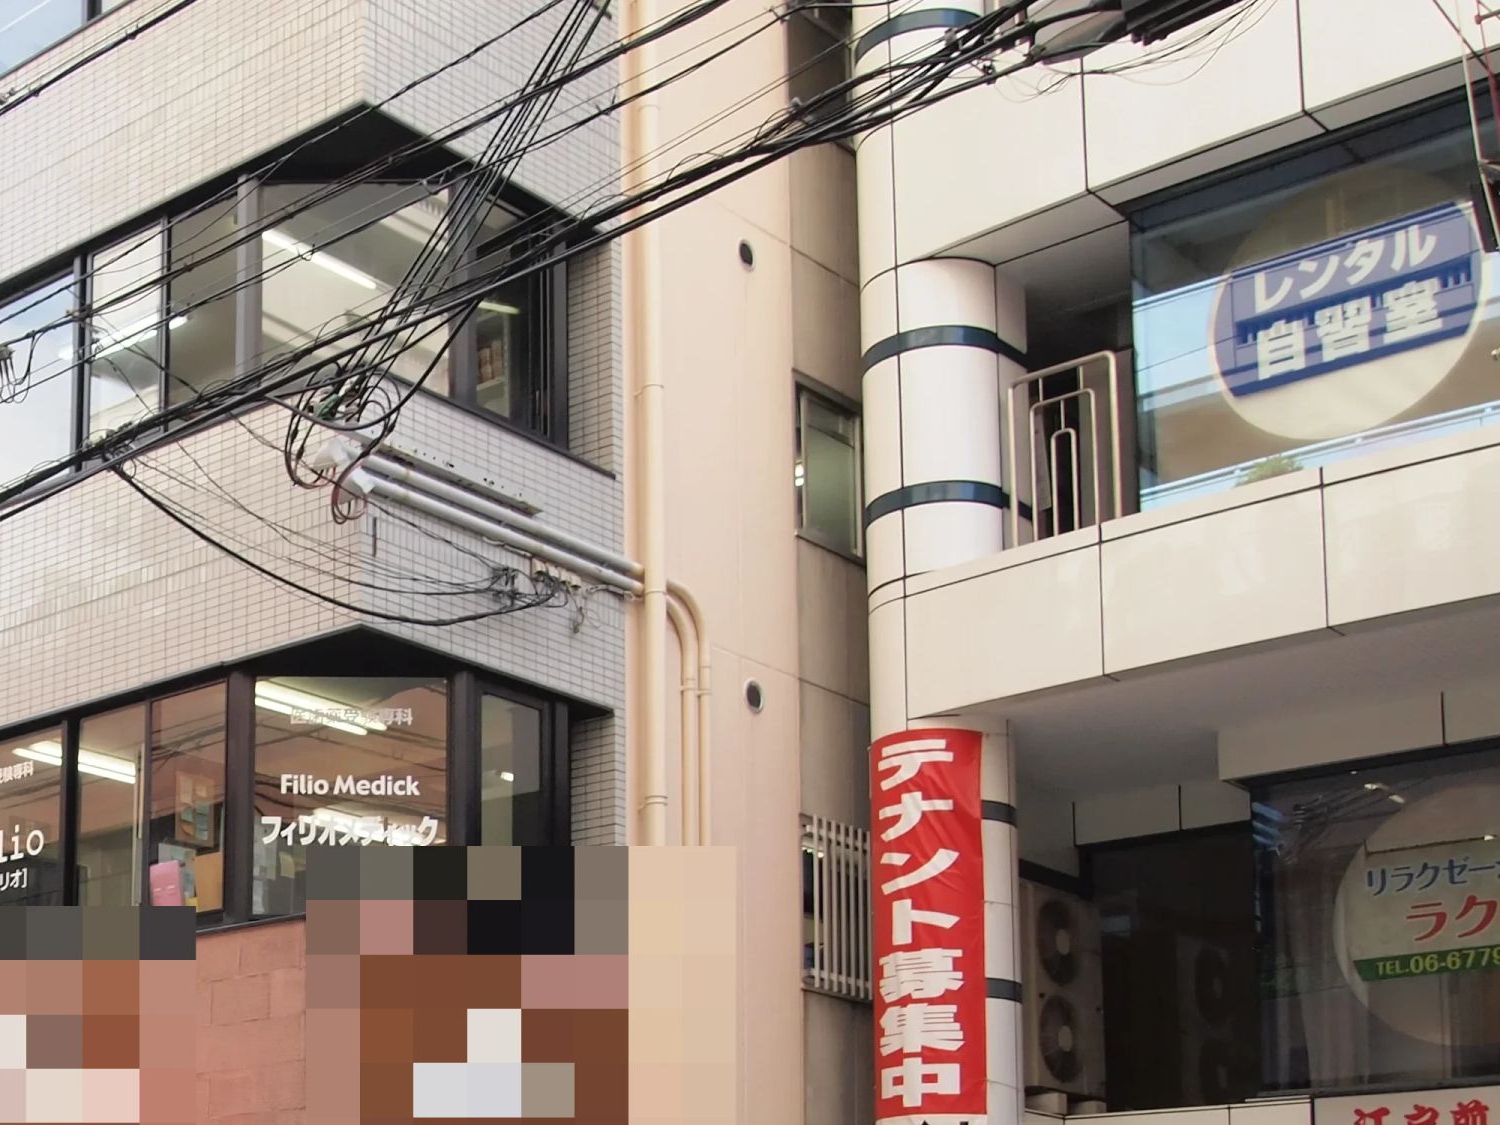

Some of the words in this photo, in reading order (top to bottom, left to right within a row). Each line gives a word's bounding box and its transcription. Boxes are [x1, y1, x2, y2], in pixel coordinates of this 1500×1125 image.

[1254, 223, 1437, 314] レンタル
[1256, 276, 1444, 381] 自習室
[280, 774, 329, 795] Filio
[332, 774, 421, 796] Medick
[1367, 856, 1500, 896] リラクゼー
[876, 737, 965, 1109] テナント募集中
[1405, 894, 1498, 942] ラク
